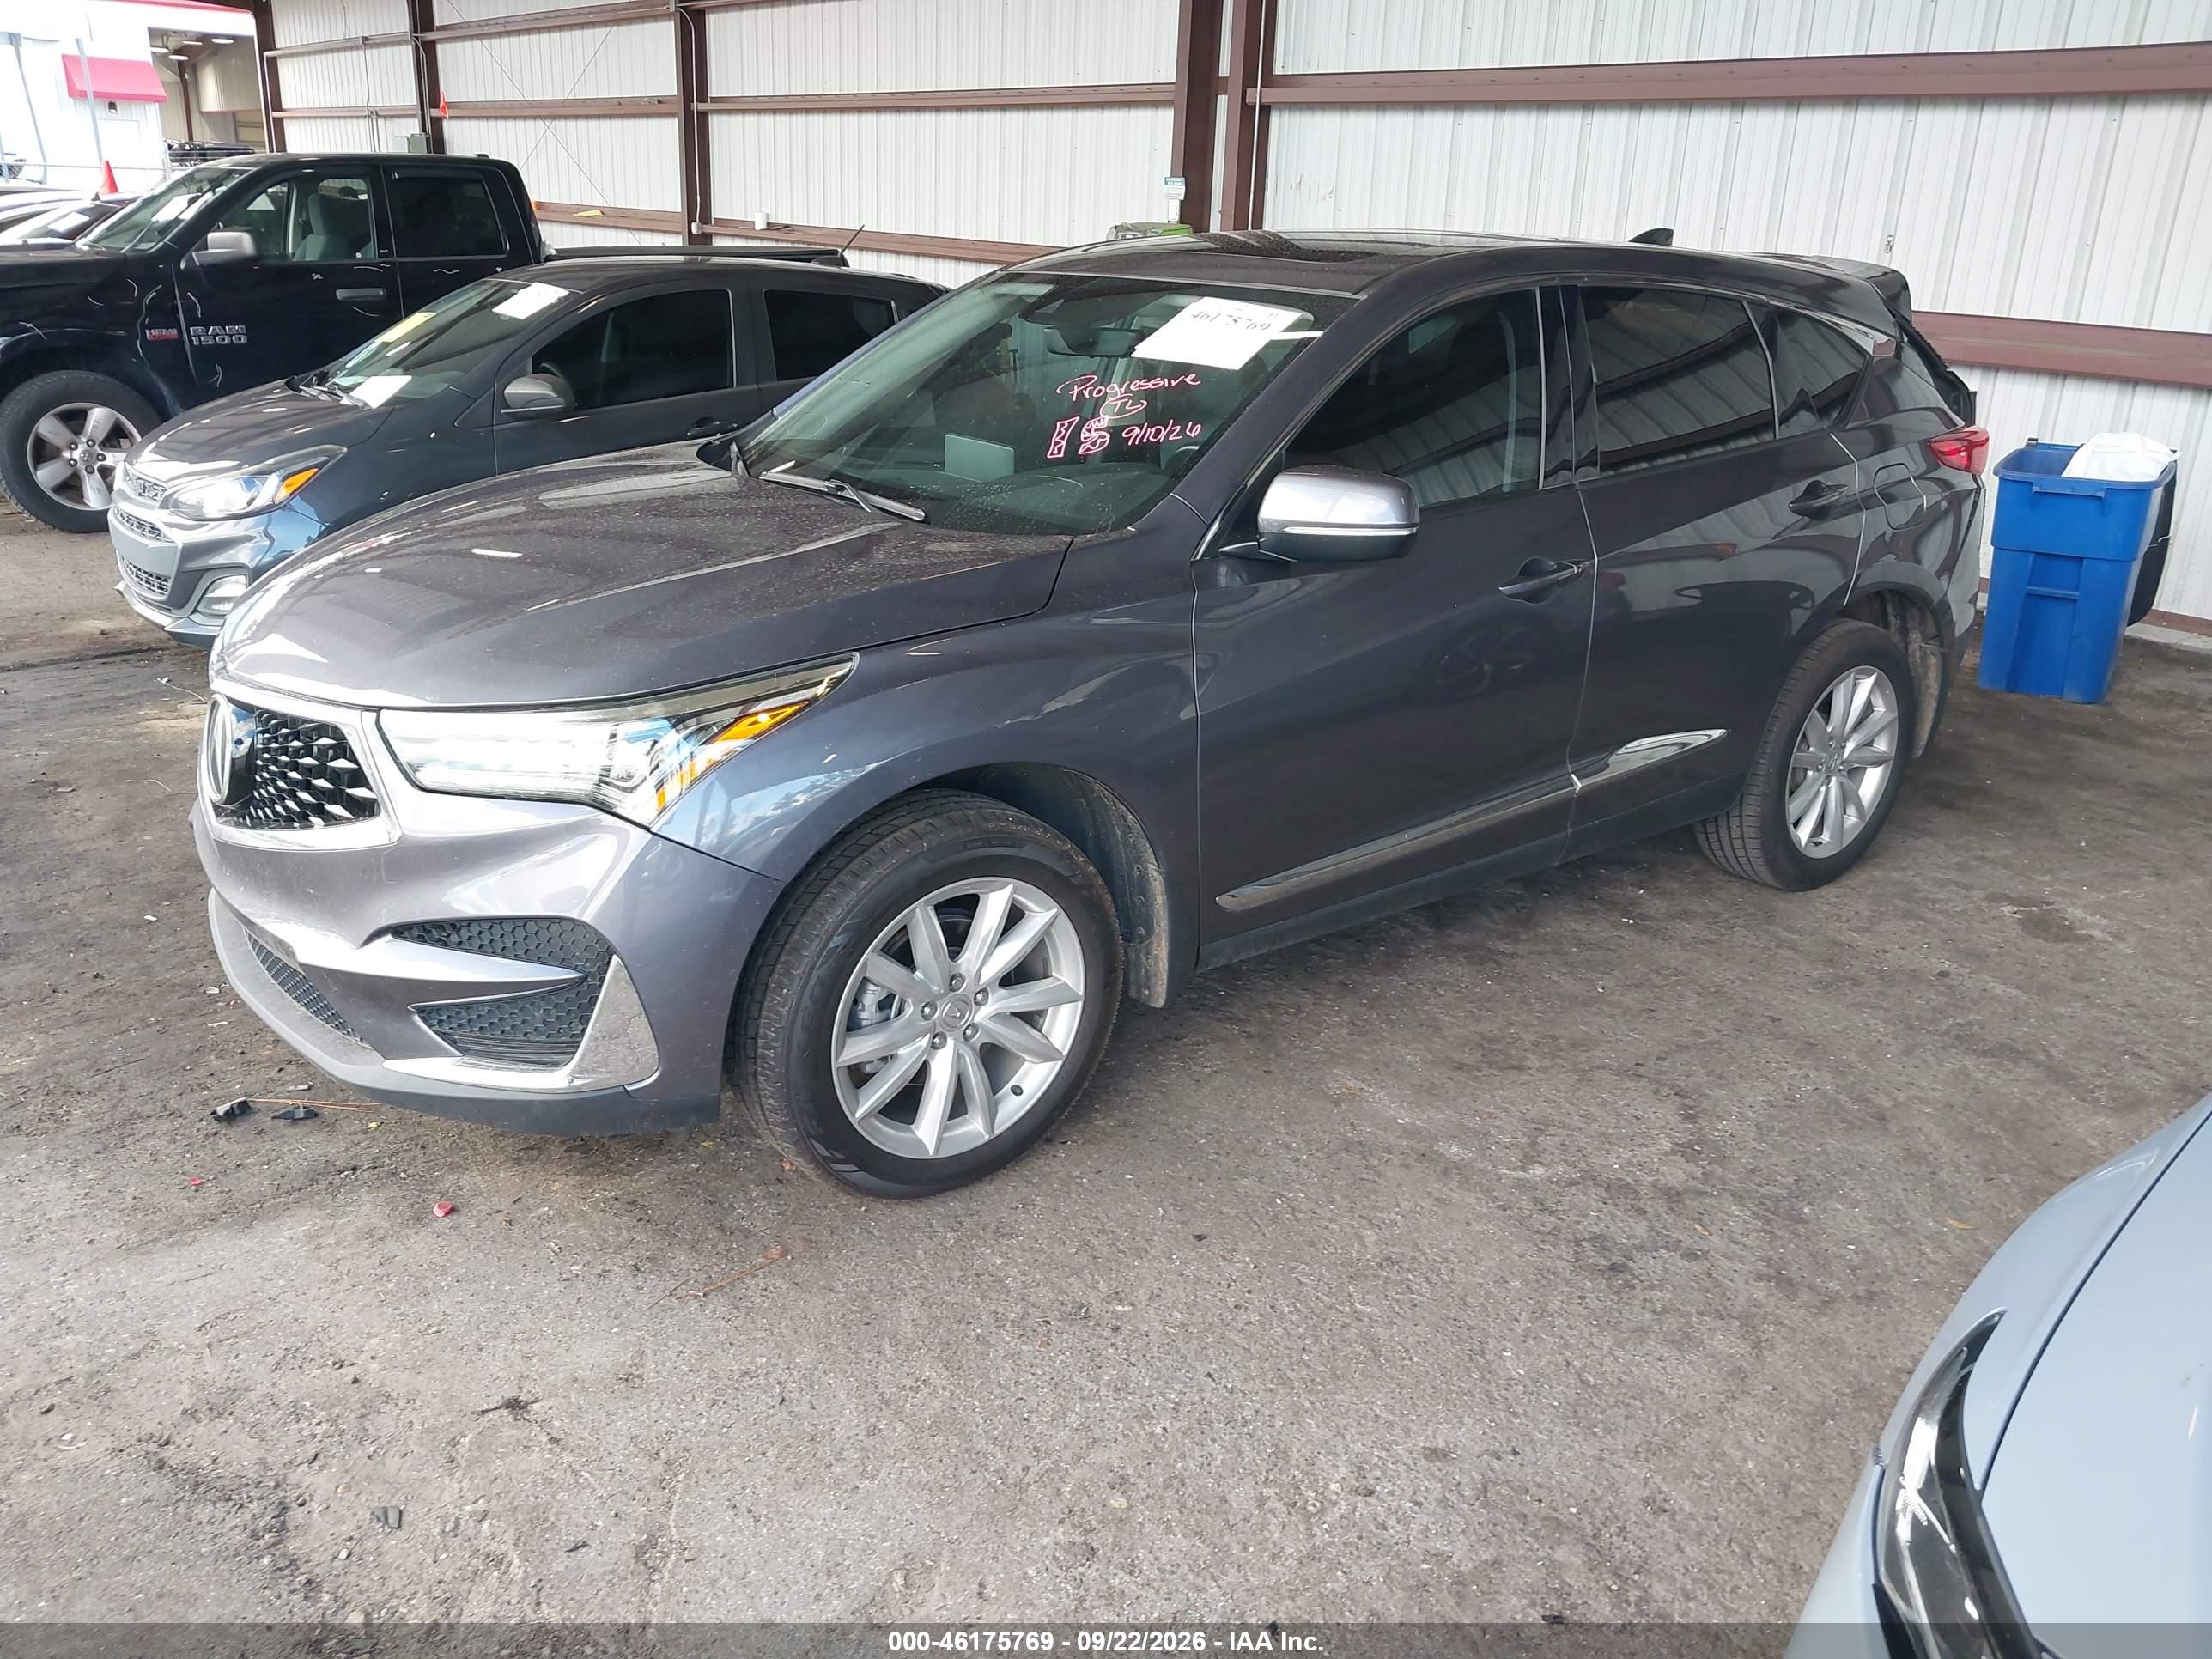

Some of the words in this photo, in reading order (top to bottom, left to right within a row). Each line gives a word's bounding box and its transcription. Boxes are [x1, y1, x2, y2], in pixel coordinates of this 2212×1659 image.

[189, 325, 246, 336] RAM
[191, 335, 247, 345] 1500
[1056, 373, 1202, 402] Progressive
[1121, 419, 1202, 446] 9/10/26
